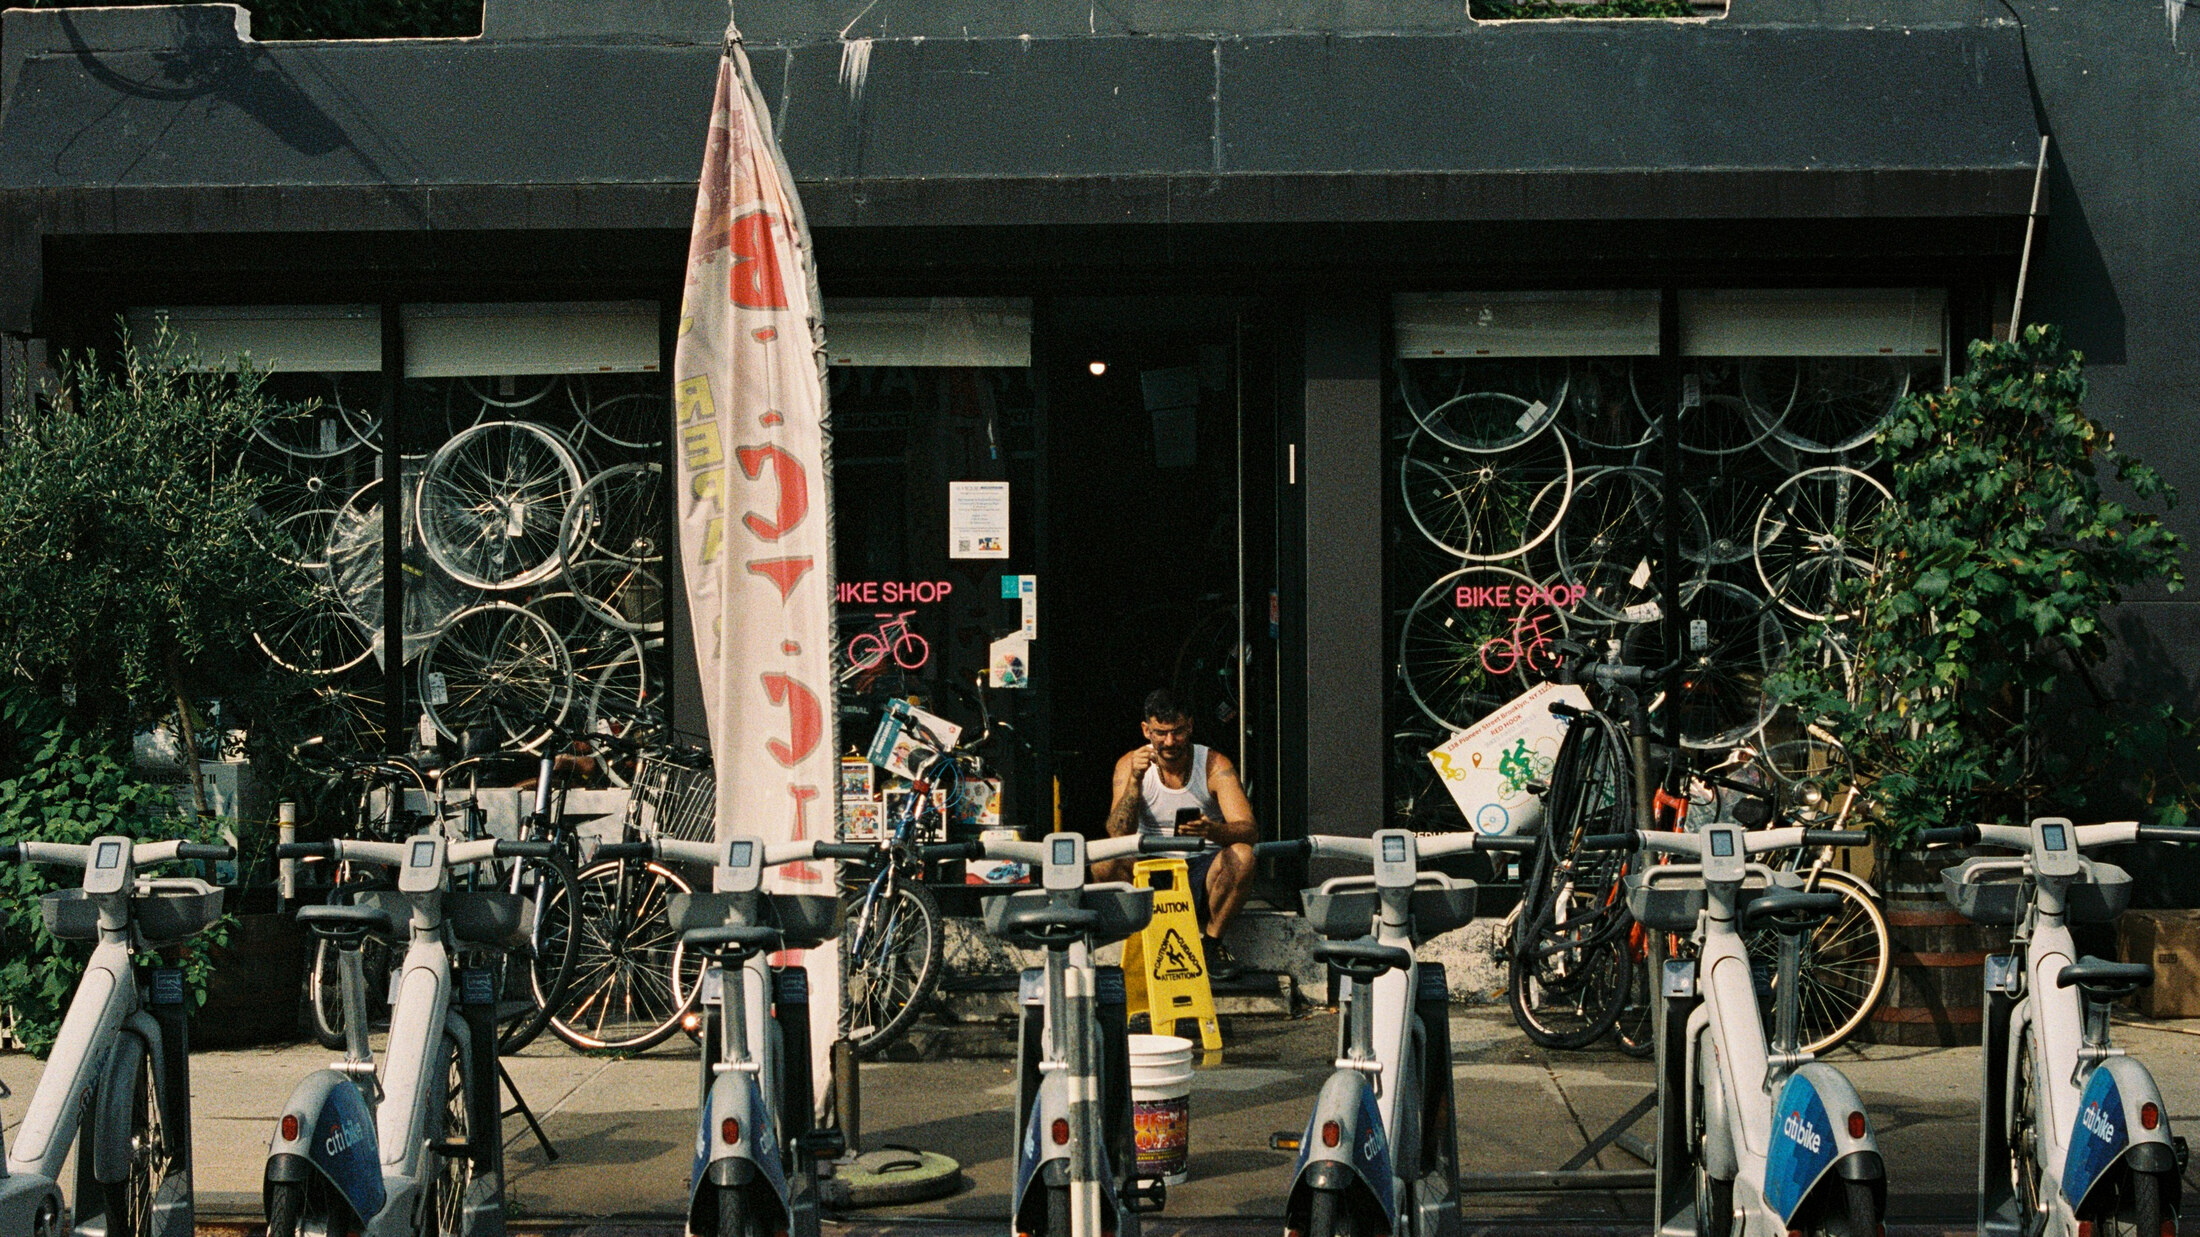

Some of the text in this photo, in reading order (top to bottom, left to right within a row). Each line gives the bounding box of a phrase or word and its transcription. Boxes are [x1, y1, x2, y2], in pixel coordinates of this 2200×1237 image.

[882, 580, 953, 603] SHOP
[1456, 584, 1587, 607] BIKE SHOP
[1459, 727, 1482, 744] Pioneer
[1482, 715, 1501, 730] Street
[1529, 693, 1538, 702] NY
[1490, 714, 1522, 736] RED HOOK
[1155, 938, 1169, 969] CAUTION
[1177, 937, 1199, 967] CUIDADO
[1161, 971, 1197, 982] ATTENTION
